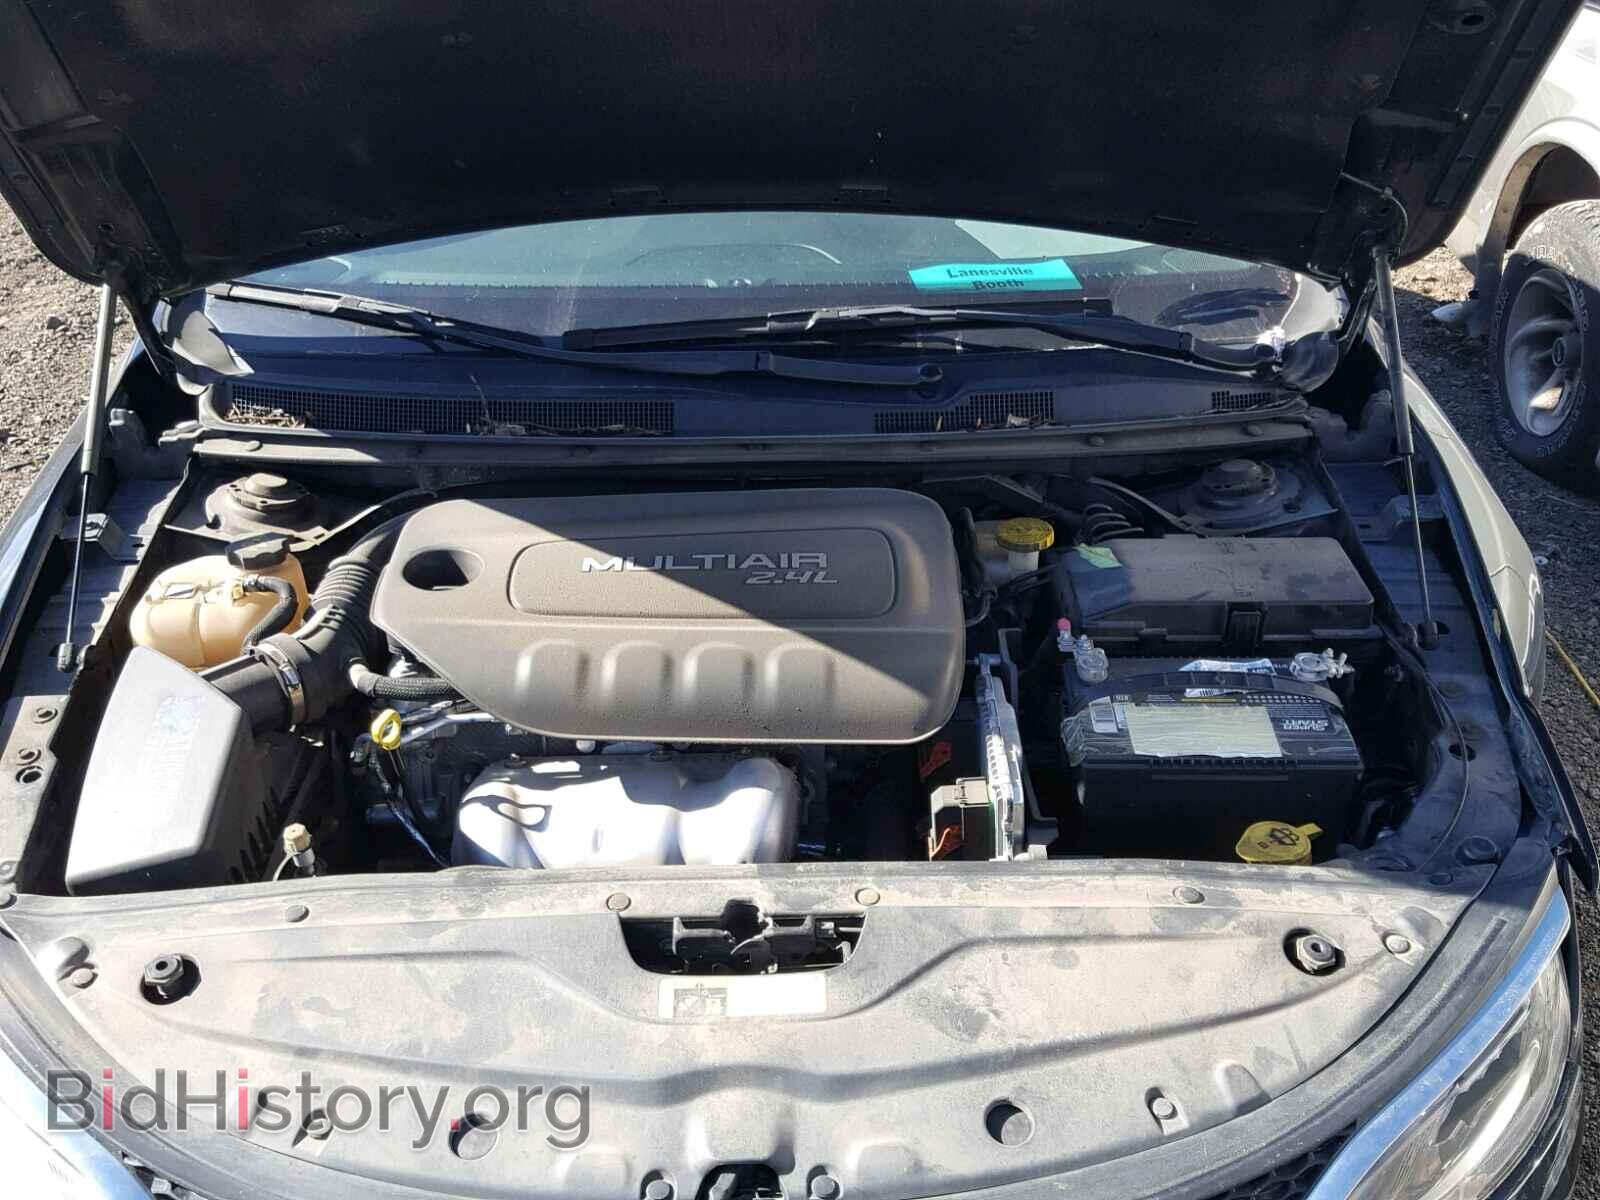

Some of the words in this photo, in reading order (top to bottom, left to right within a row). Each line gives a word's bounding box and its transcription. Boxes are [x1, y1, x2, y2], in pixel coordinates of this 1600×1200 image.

[947, 267, 1034, 279] Lanesville
[972, 279, 1025, 291] Booth
[581, 552, 828, 573] MULTIAIR
[745, 571, 838, 585] 2.4L
